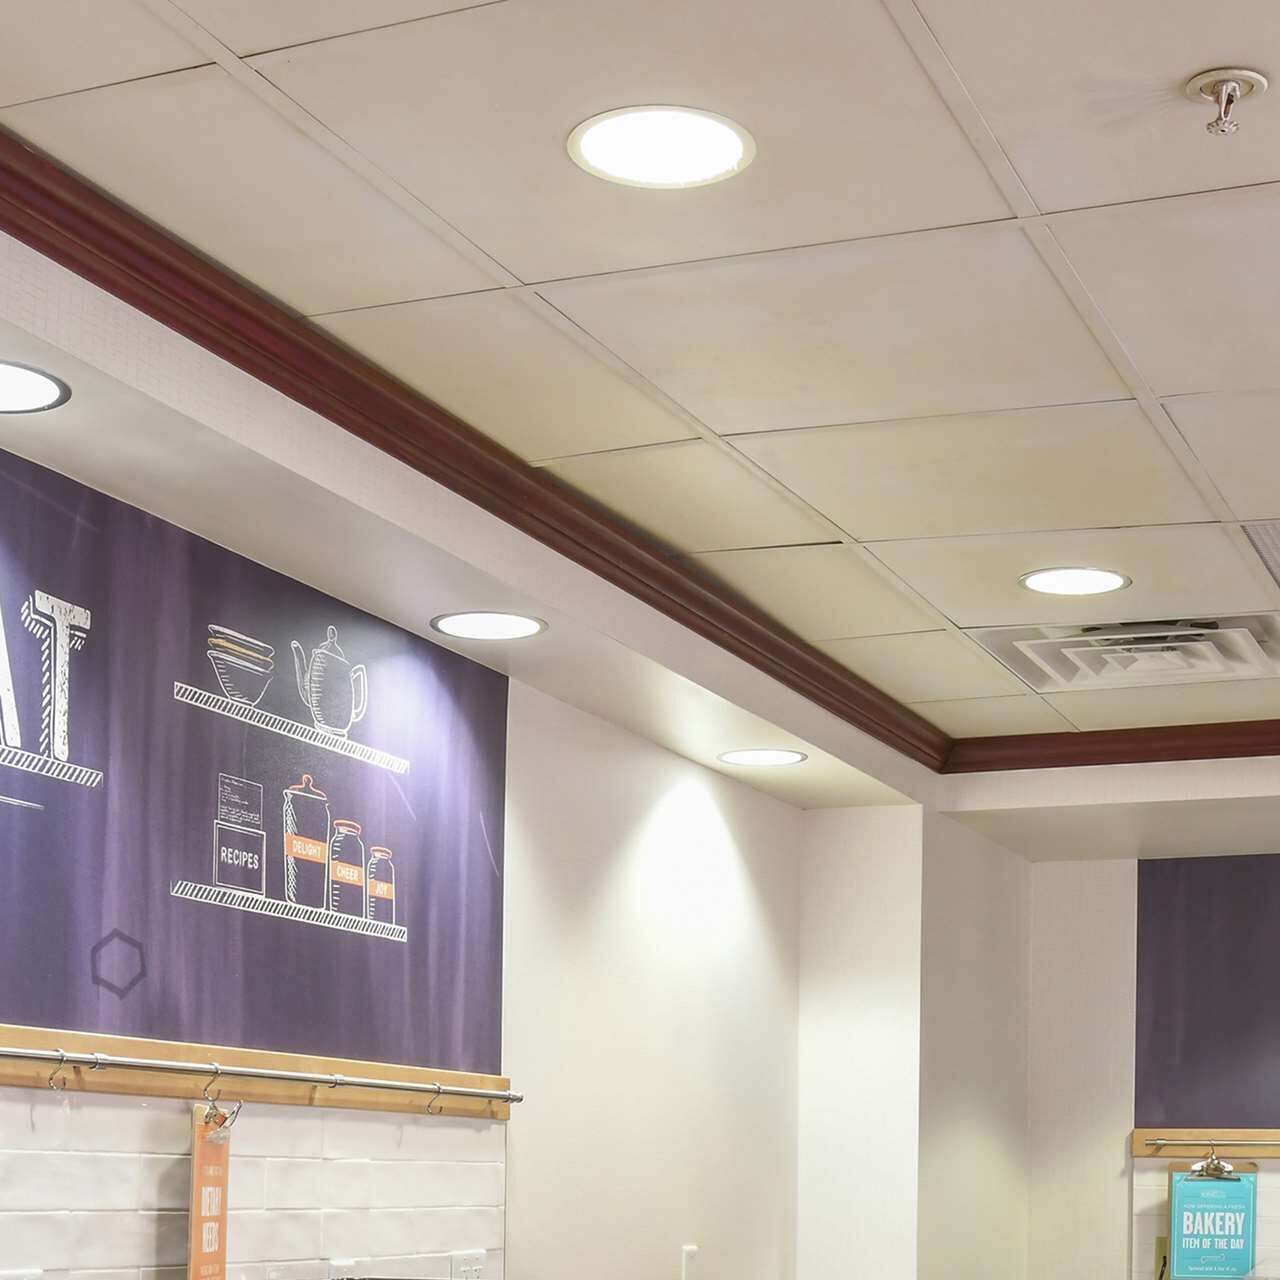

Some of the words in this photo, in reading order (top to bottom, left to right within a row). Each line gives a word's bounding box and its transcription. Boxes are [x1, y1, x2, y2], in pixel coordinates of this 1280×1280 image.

[293, 840, 321, 857] DELIGHT
[221, 846, 259, 870] RECIPES
[336, 866, 359, 882] CHEER
[1182, 1211, 1246, 1236] BAKERY
[1182, 1237, 1201, 1249] ITEM
[1202, 1238, 1212, 1249] OF
[1214, 1238, 1228, 1249] THE
[1230, 1238, 1245, 1249] DAY
